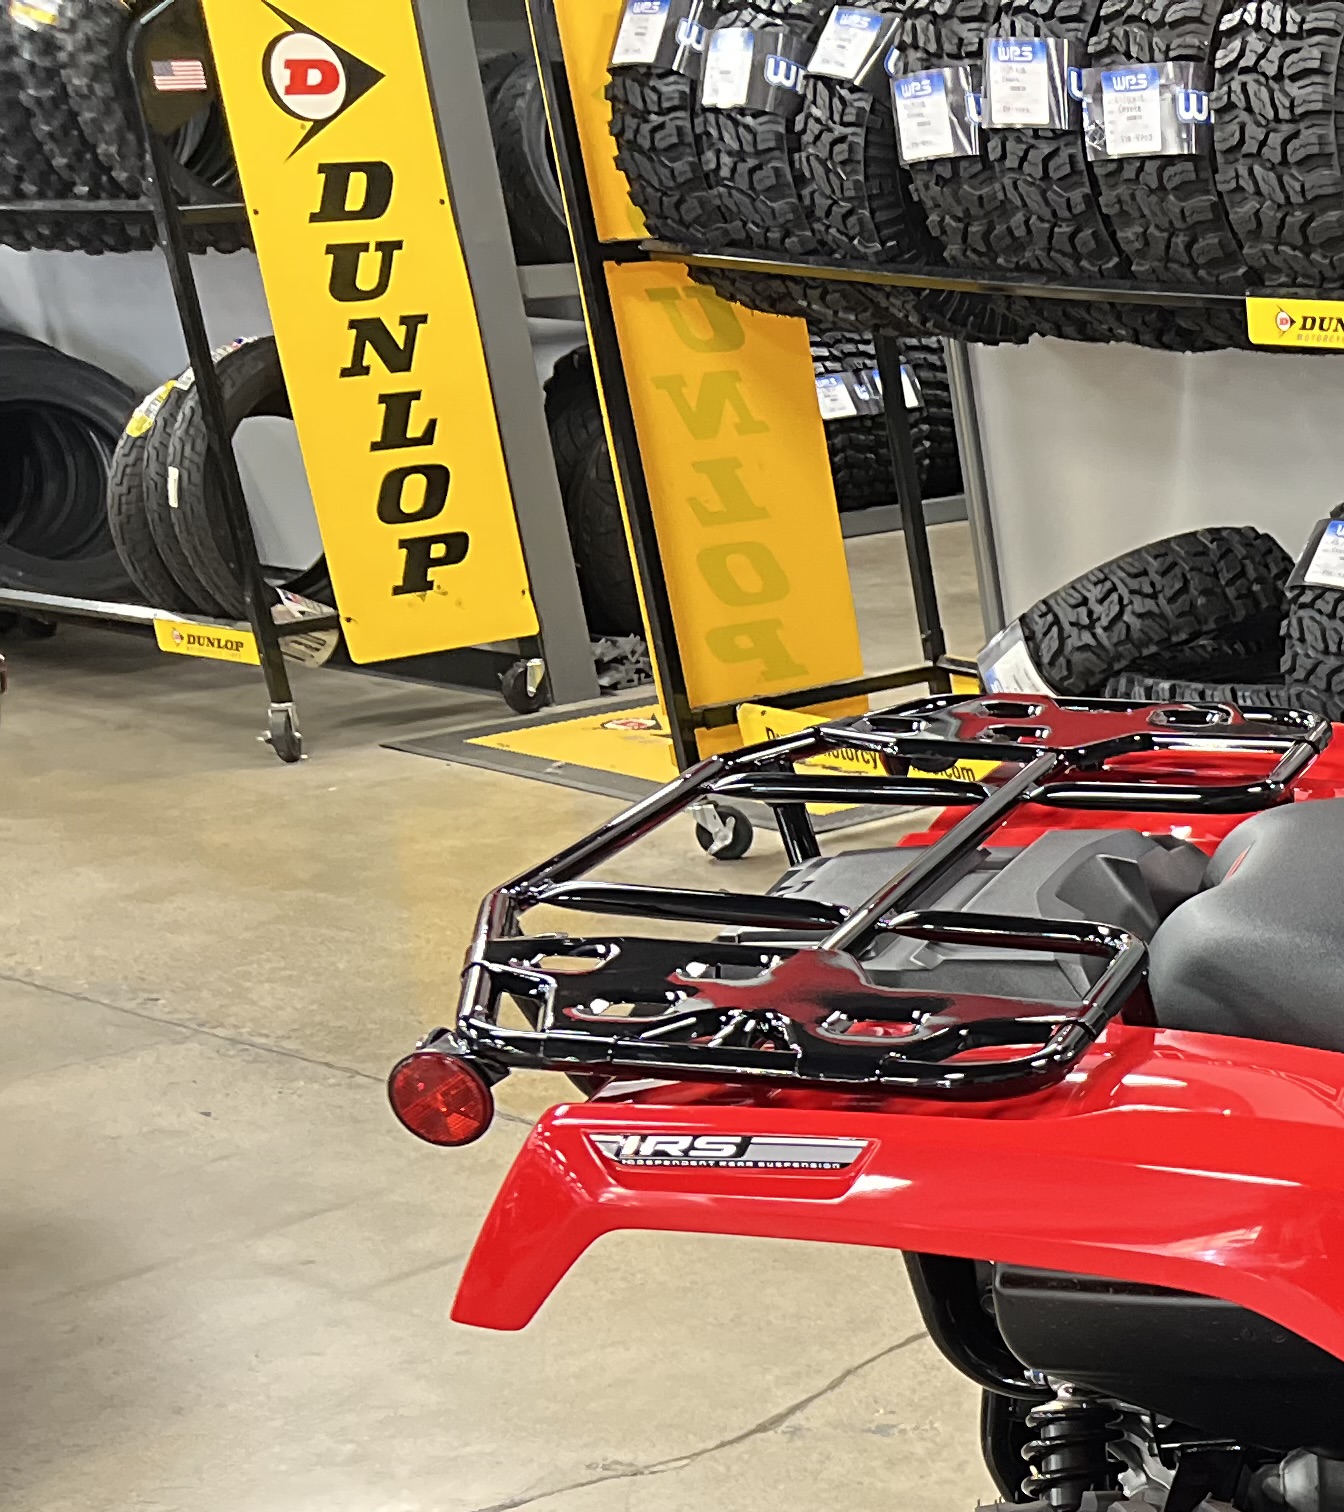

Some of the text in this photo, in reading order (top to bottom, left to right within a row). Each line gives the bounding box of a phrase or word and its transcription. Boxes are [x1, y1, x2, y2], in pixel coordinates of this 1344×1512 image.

[997, 44, 1034, 62] WPS
[283, 59, 341, 96] D
[1112, 73, 1148, 91] WPS
[901, 79, 932, 98] WPS
[309, 161, 469, 596] DUNLOP
[187, 634, 244, 652] DUNLOP
[620, 1135, 742, 1157] IRS
[621, 1158, 841, 1169] INDEPENDENT REAR SUSPENSION
